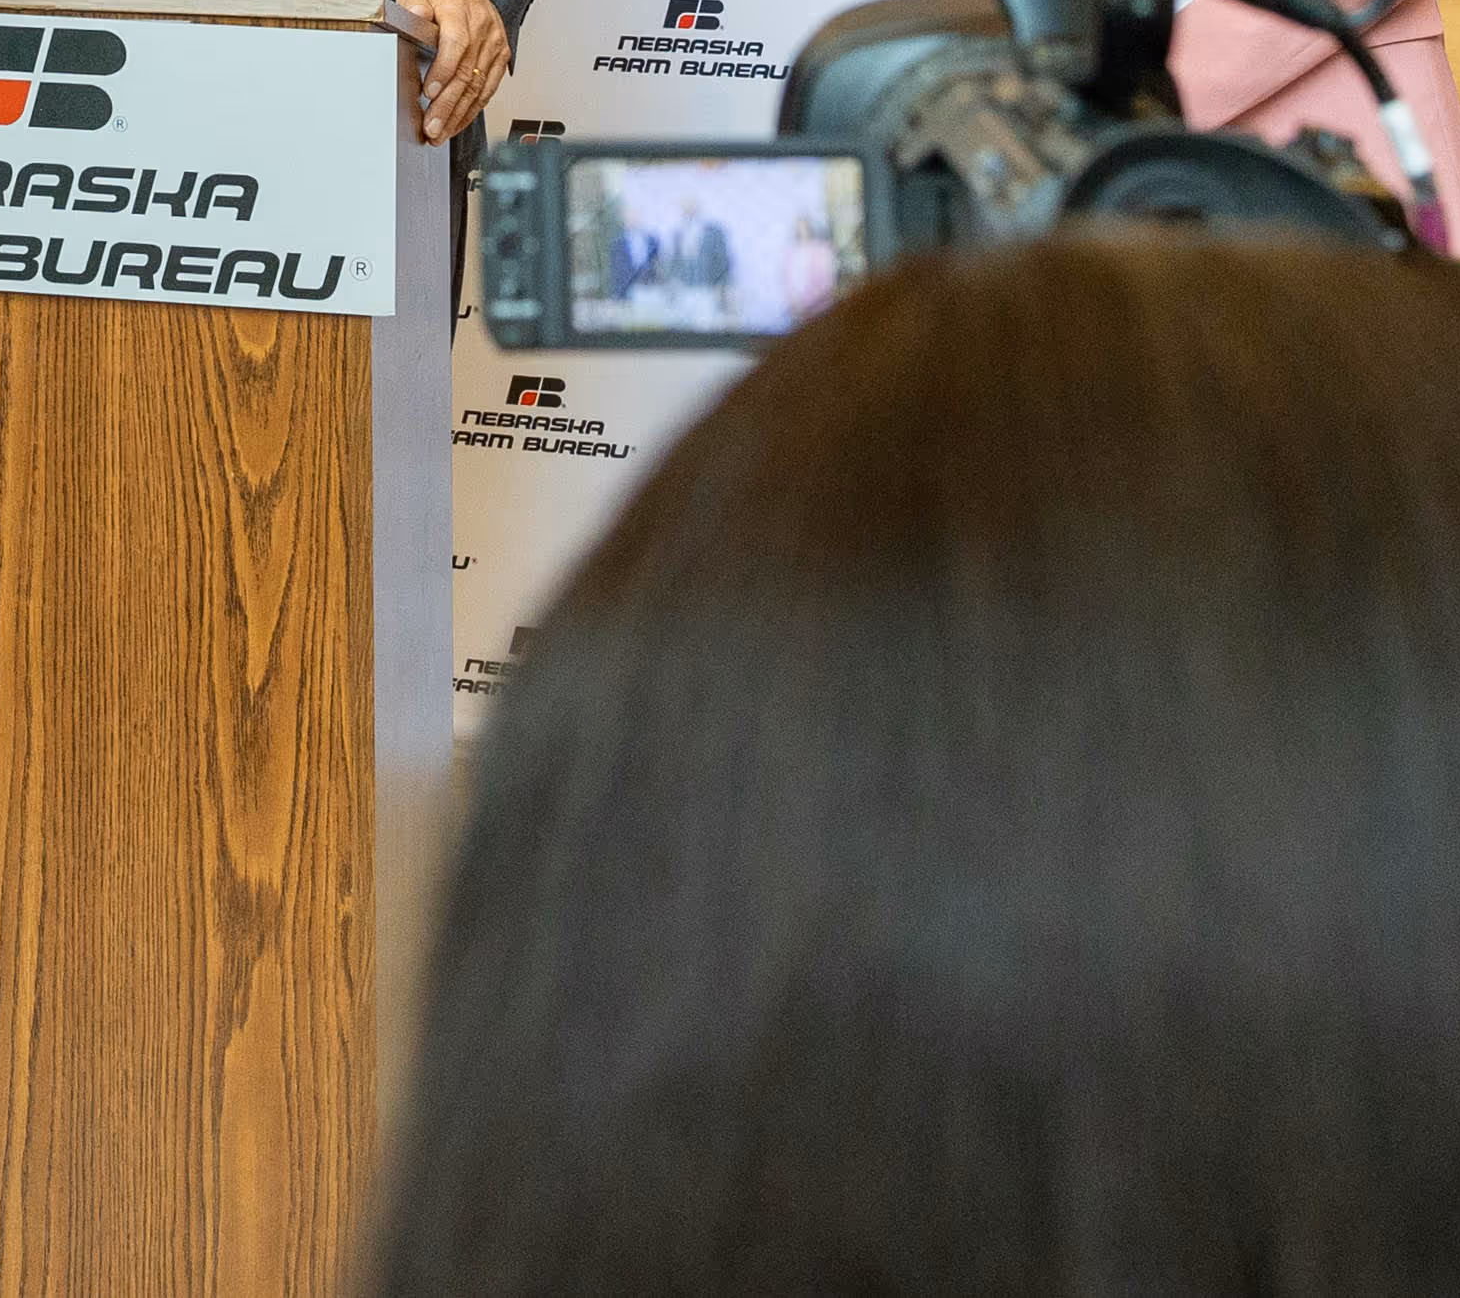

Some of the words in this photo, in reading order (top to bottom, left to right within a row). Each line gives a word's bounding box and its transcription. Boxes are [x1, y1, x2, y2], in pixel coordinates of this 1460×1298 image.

[618, 36, 763, 56] NEBRASKA
[593, 57, 671, 74] FARM
[679, 60, 790, 80] BUREAU
[462, 410, 604, 435] NEBRASKA
[451, 430, 514, 449] ARM
[523, 437, 630, 458] BUREAU
